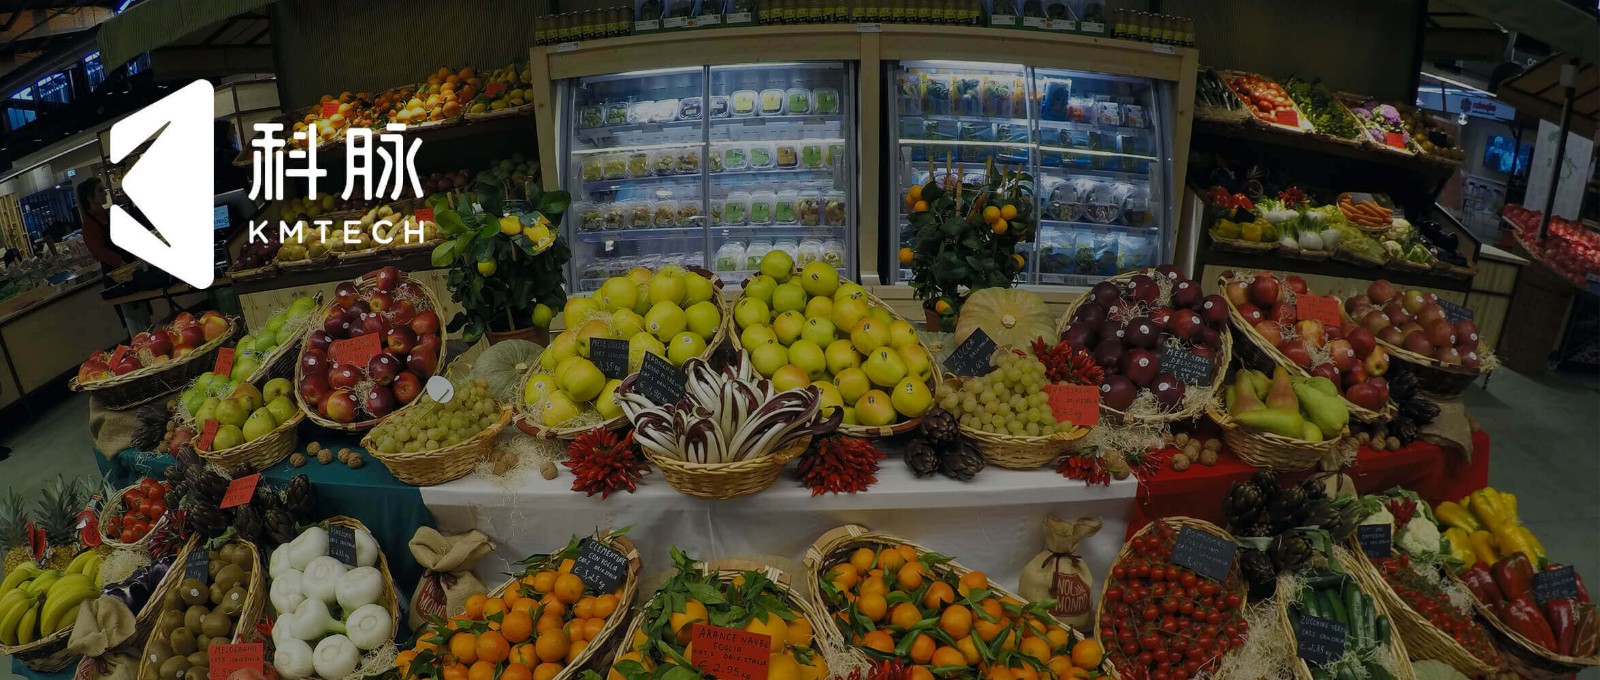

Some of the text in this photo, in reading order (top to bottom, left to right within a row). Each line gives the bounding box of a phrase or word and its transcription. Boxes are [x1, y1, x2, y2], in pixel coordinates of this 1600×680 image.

[952, 338, 976, 367] ZUCCA
[1166, 348, 1189, 360] MELE
[646, 352, 676, 376] RADICCHIO
[588, 552, 601, 562] CON
[589, 541, 628, 566] CLEMENTINE
[697, 627, 769, 649] ARANCE NAVEL
[214, 645, 258, 654] MELOGRANO
[713, 641, 743, 653] FOGLIA
